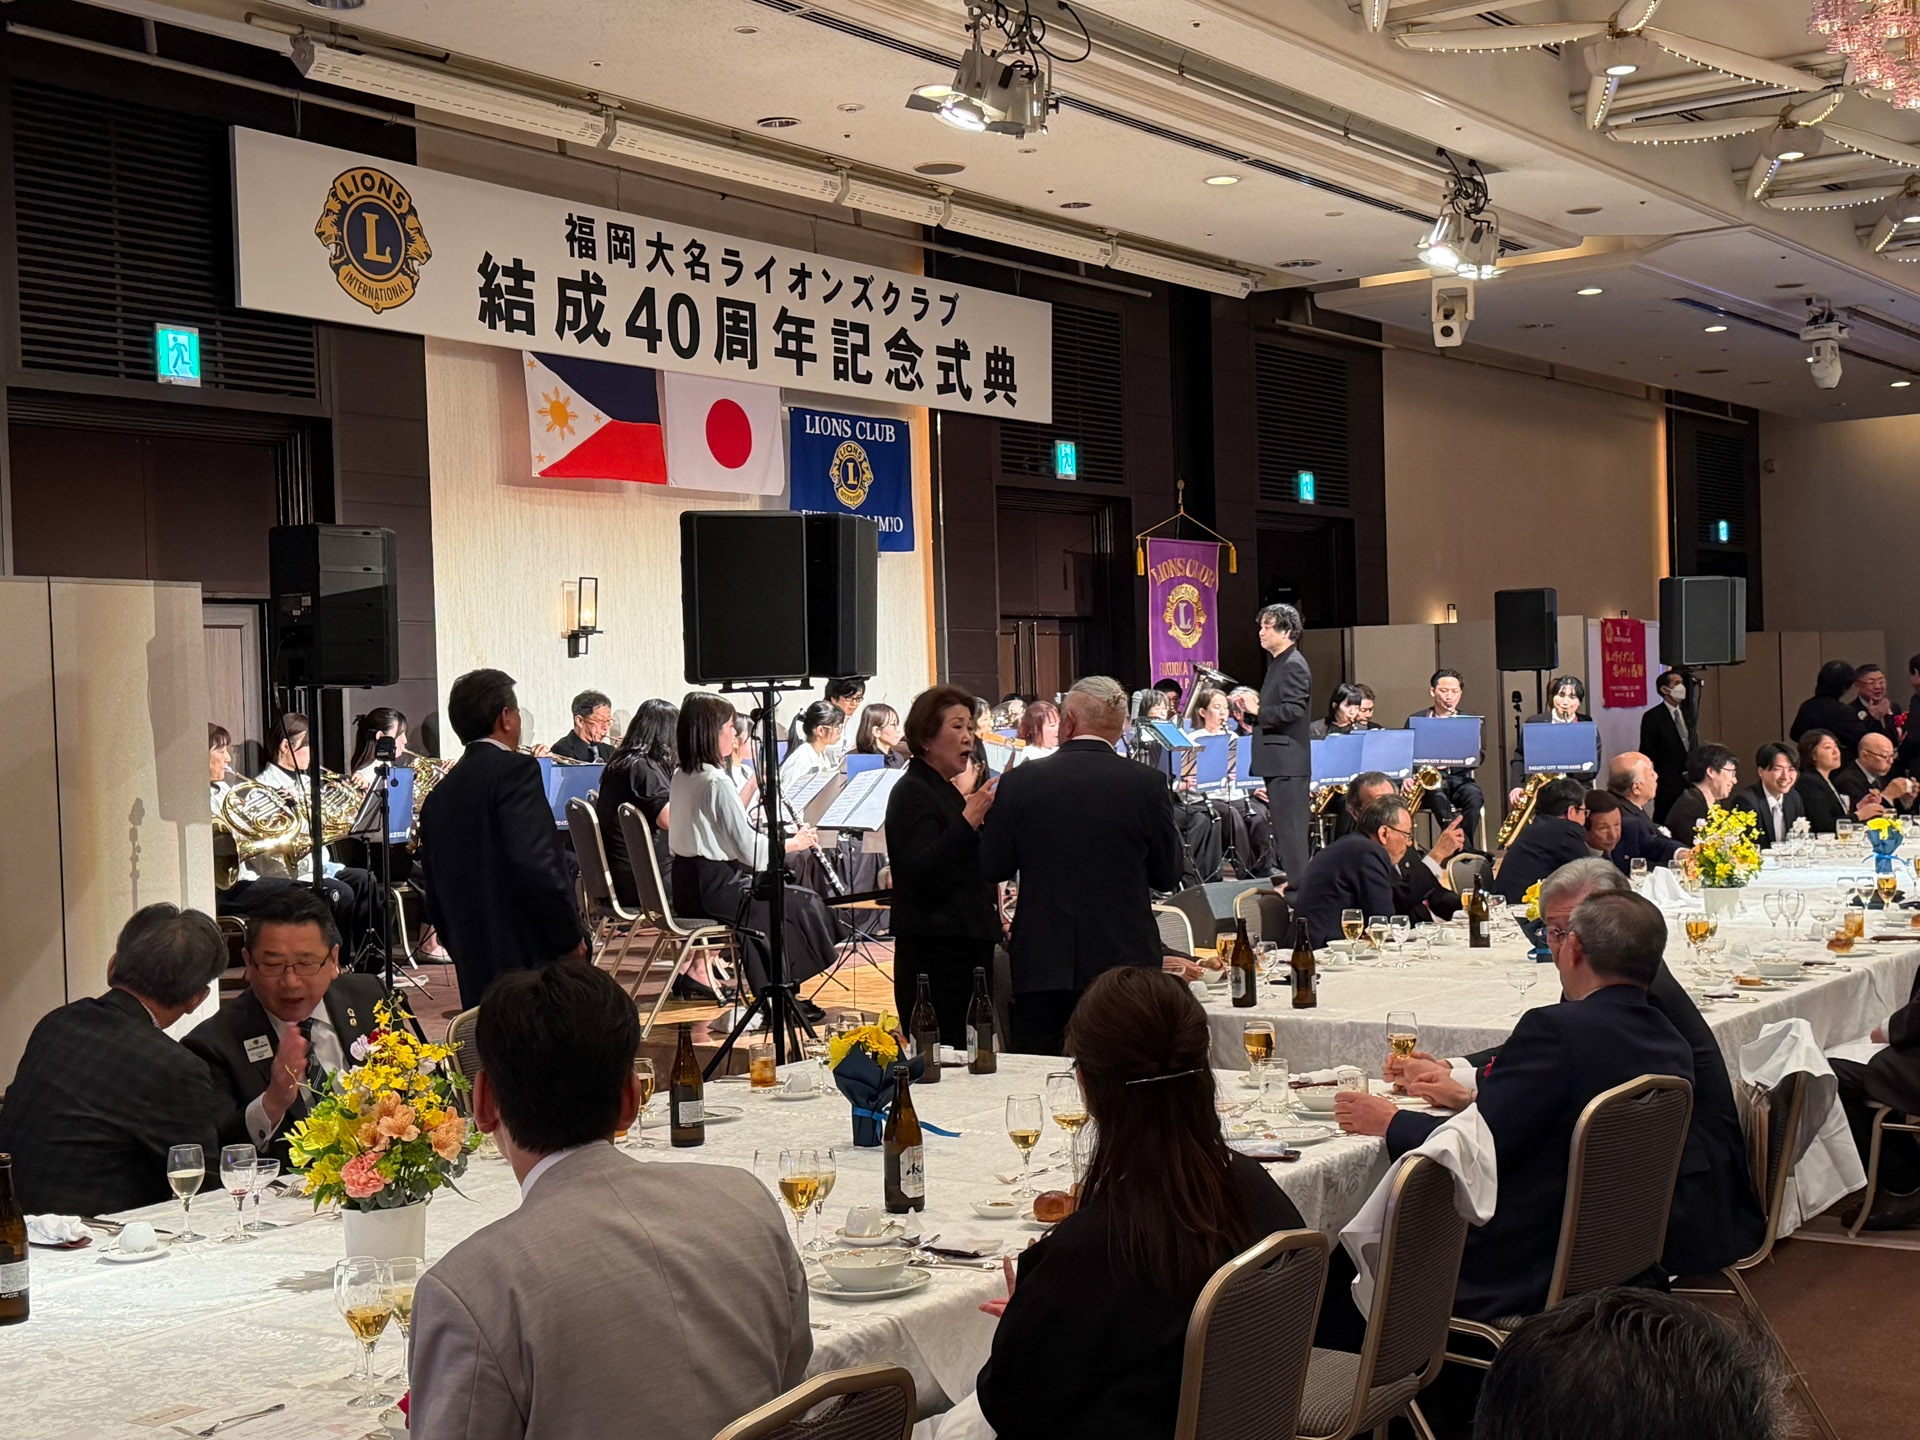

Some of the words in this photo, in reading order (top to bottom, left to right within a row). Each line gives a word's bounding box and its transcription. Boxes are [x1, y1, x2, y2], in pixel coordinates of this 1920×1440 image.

[340, 173, 406, 209] LIONS
[362, 212, 392, 264] L
[565, 213, 960, 327] 福岡大名ライオンズクラブ
[344, 271, 409, 302] INTERNATIONAL
[477, 250, 1018, 408] 結成40周年記念式典
[805, 414, 852, 438] LIONS
[855, 420, 896, 442] CLUB
[839, 445, 863, 461] LIONS
[847, 462, 858, 485] L
[1151, 558, 1186, 587] LIONS
[1187, 559, 1216, 587] CLUB
[1178, 603, 1192, 629] L
